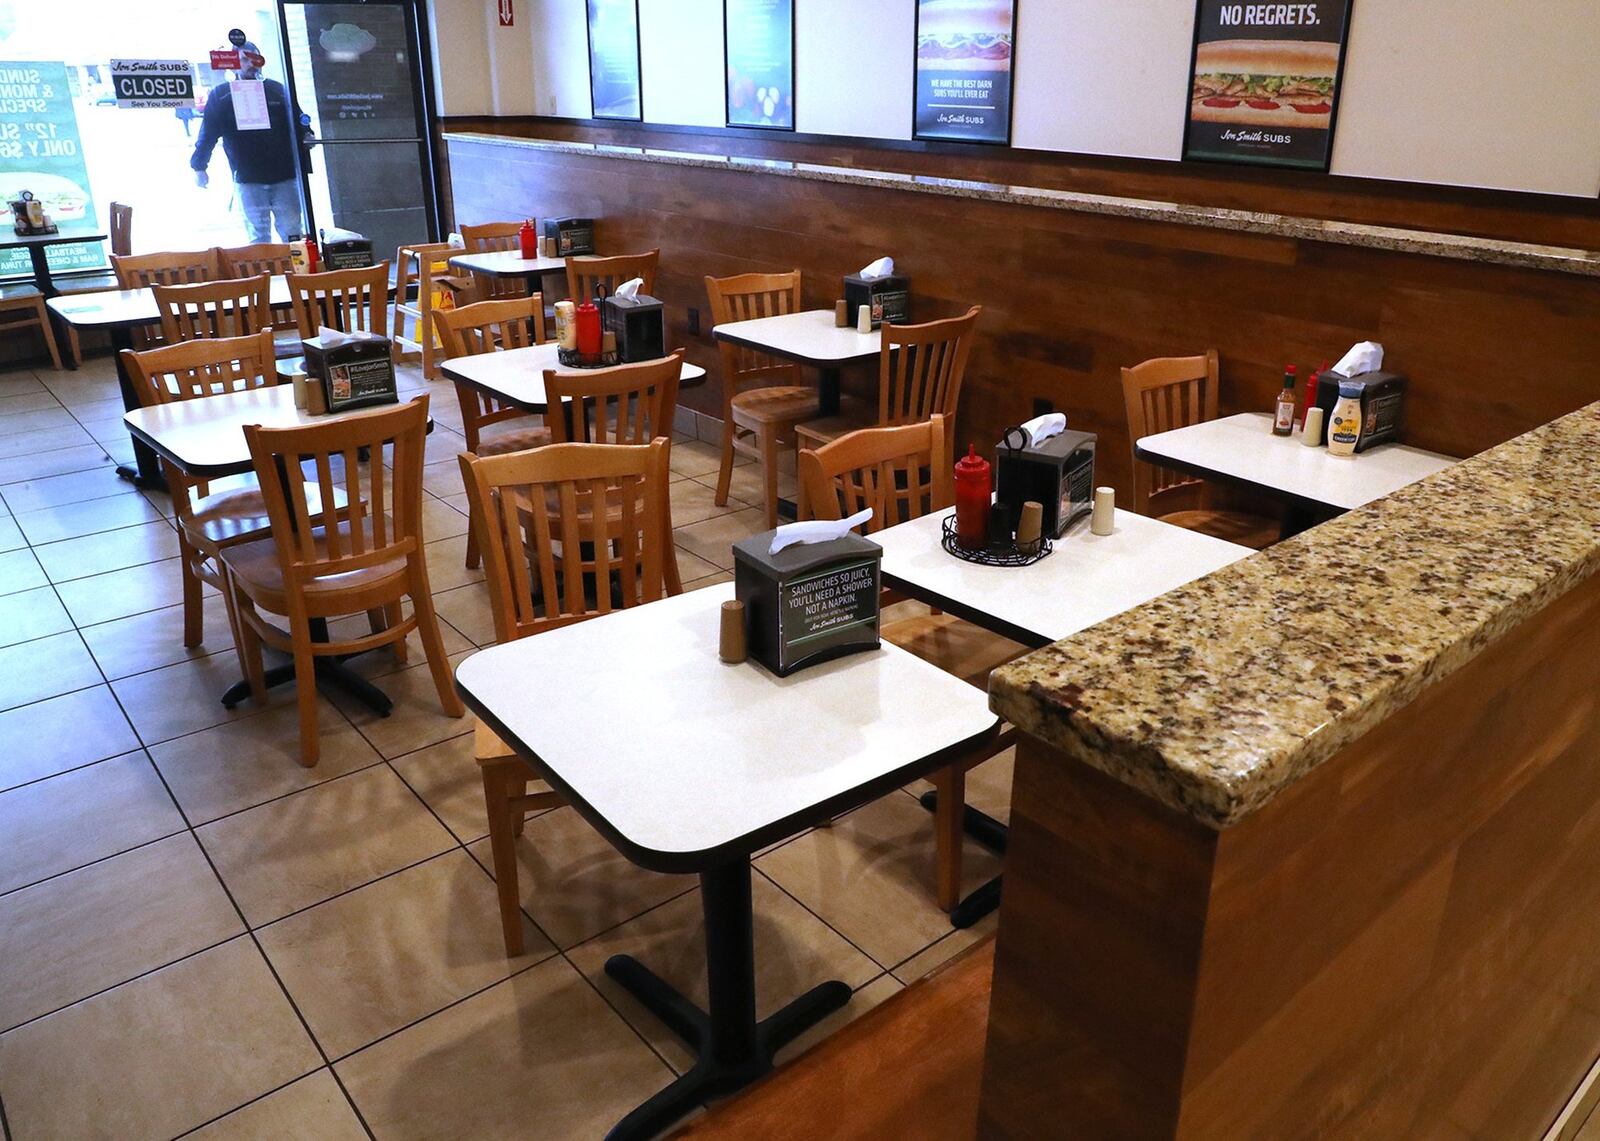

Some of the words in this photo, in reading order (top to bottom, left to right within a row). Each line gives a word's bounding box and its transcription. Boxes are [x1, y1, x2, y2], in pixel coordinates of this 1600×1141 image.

[1220, 5, 1242, 26] NO
[1244, 4, 1321, 26] REGRETS.
[113, 62, 130, 72] Jon
[130, 62, 158, 72] Smith
[120, 78, 188, 96] CLOSED
[931, 79, 939, 88] WE
[940, 79, 952, 88] HAVE
[953, 80, 962, 88] THE
[963, 80, 976, 88] BEST
[977, 80, 993, 89] DARN
[934, 89, 947, 98] SUBS
[947, 90, 964, 98] YOU'LL
[964, 90, 978, 98] EVER
[978, 90, 989, 99] EAT
[131, 100, 145, 108] See
[146, 100, 160, 108] You
[162, 100, 184, 108] Soon!
[937, 114, 947, 122] Jon
[947, 114, 965, 124] Smith
[1220, 129, 1235, 140] Jon
[1236, 130, 1262, 142] Smith
[1262, 133, 1292, 144] SUBS
[792, 575, 839, 597] SANDWICHES
[840, 572, 850, 582] SO
[788, 594, 814, 609] YOU'LL
[815, 588, 835, 602] NEED
[835, 586, 841, 595] A
[842, 578, 873, 594] SHOWER
[805, 604, 820, 616] NOT
[822, 602, 828, 610] A
[828, 594, 856, 608] NAPKIN.
[836, 614, 854, 623] SUBS
